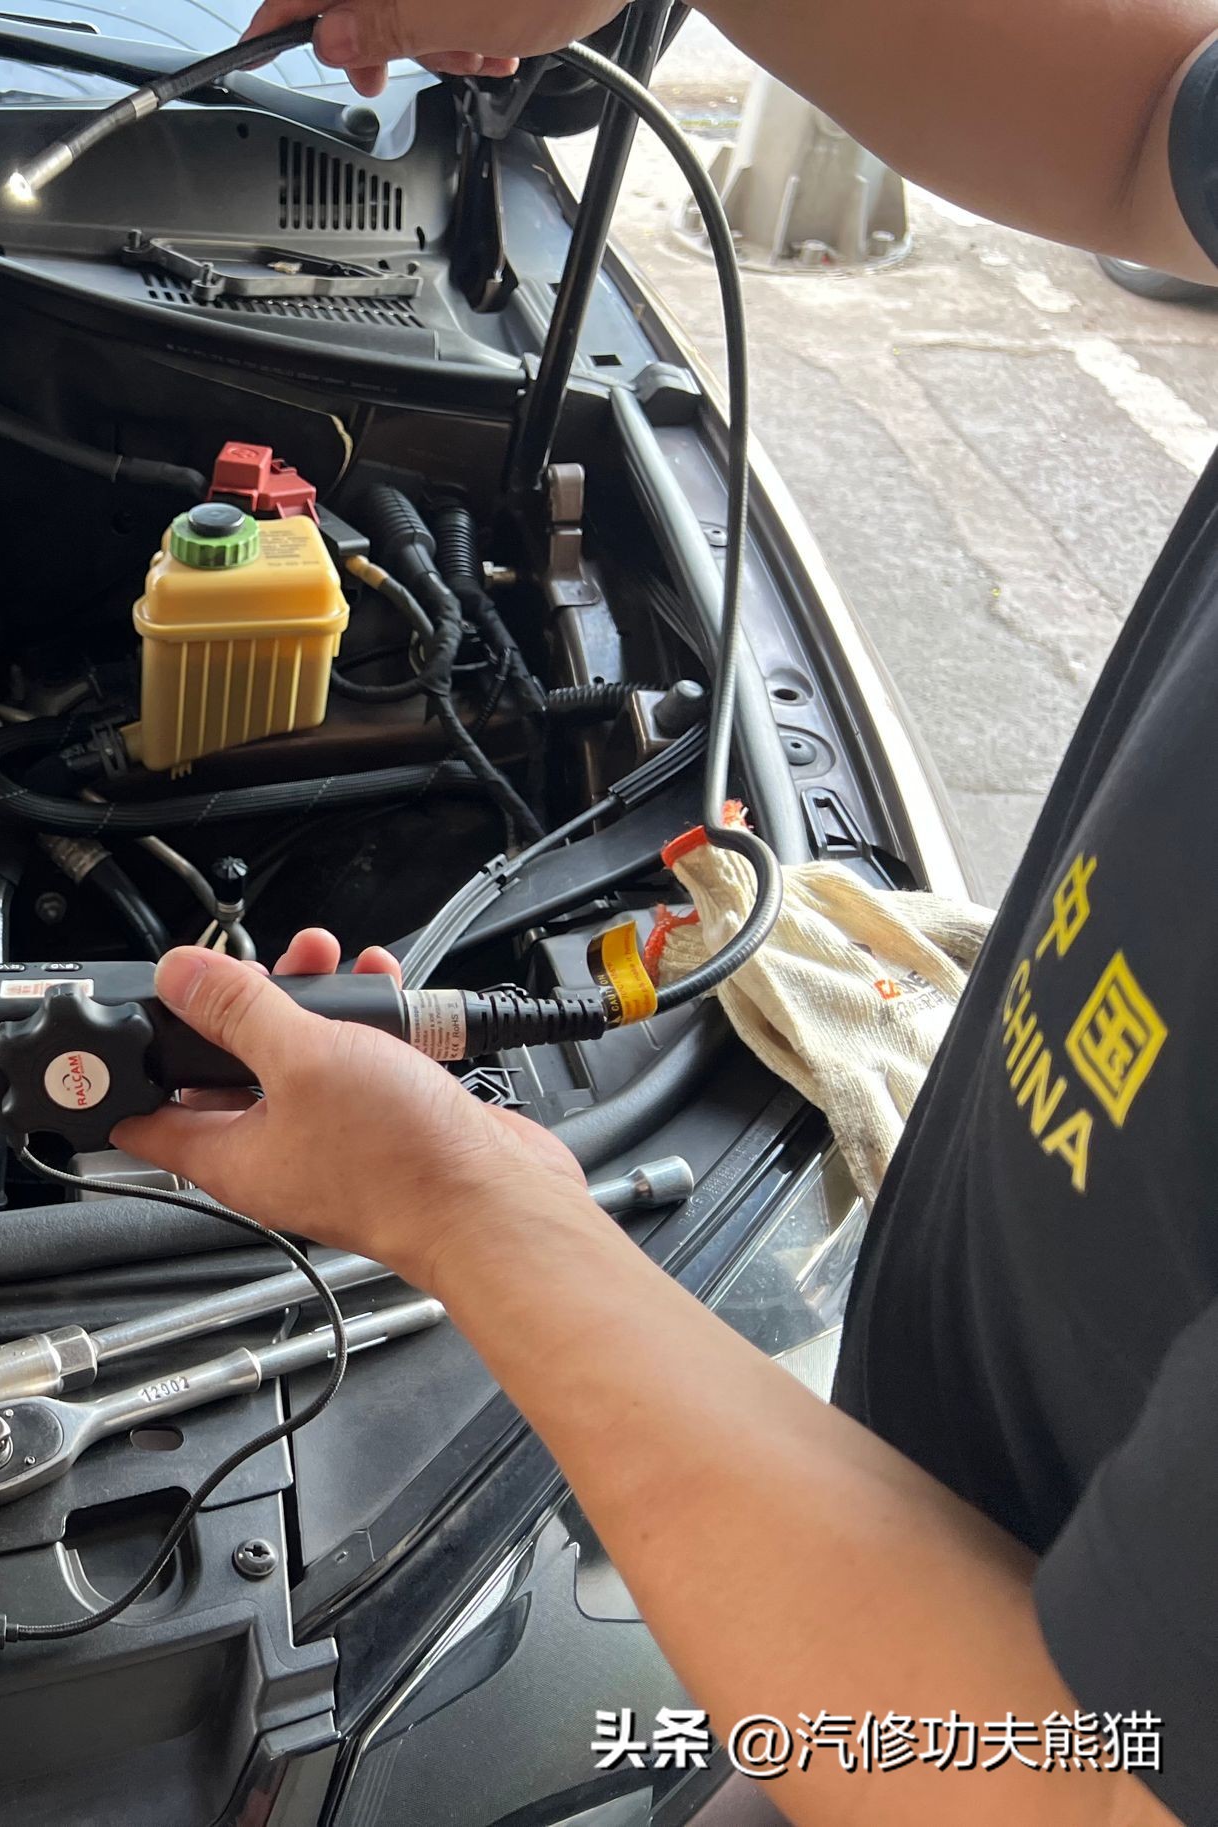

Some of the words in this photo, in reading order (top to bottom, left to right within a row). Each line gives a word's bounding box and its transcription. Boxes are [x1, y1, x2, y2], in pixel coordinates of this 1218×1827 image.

[597, 974, 620, 1012] CAUTON
[68, 1054, 87, 1107] RALCAM
[1002, 958, 1094, 1194] CHINA
[141, 1376, 190, 1401] 12902
